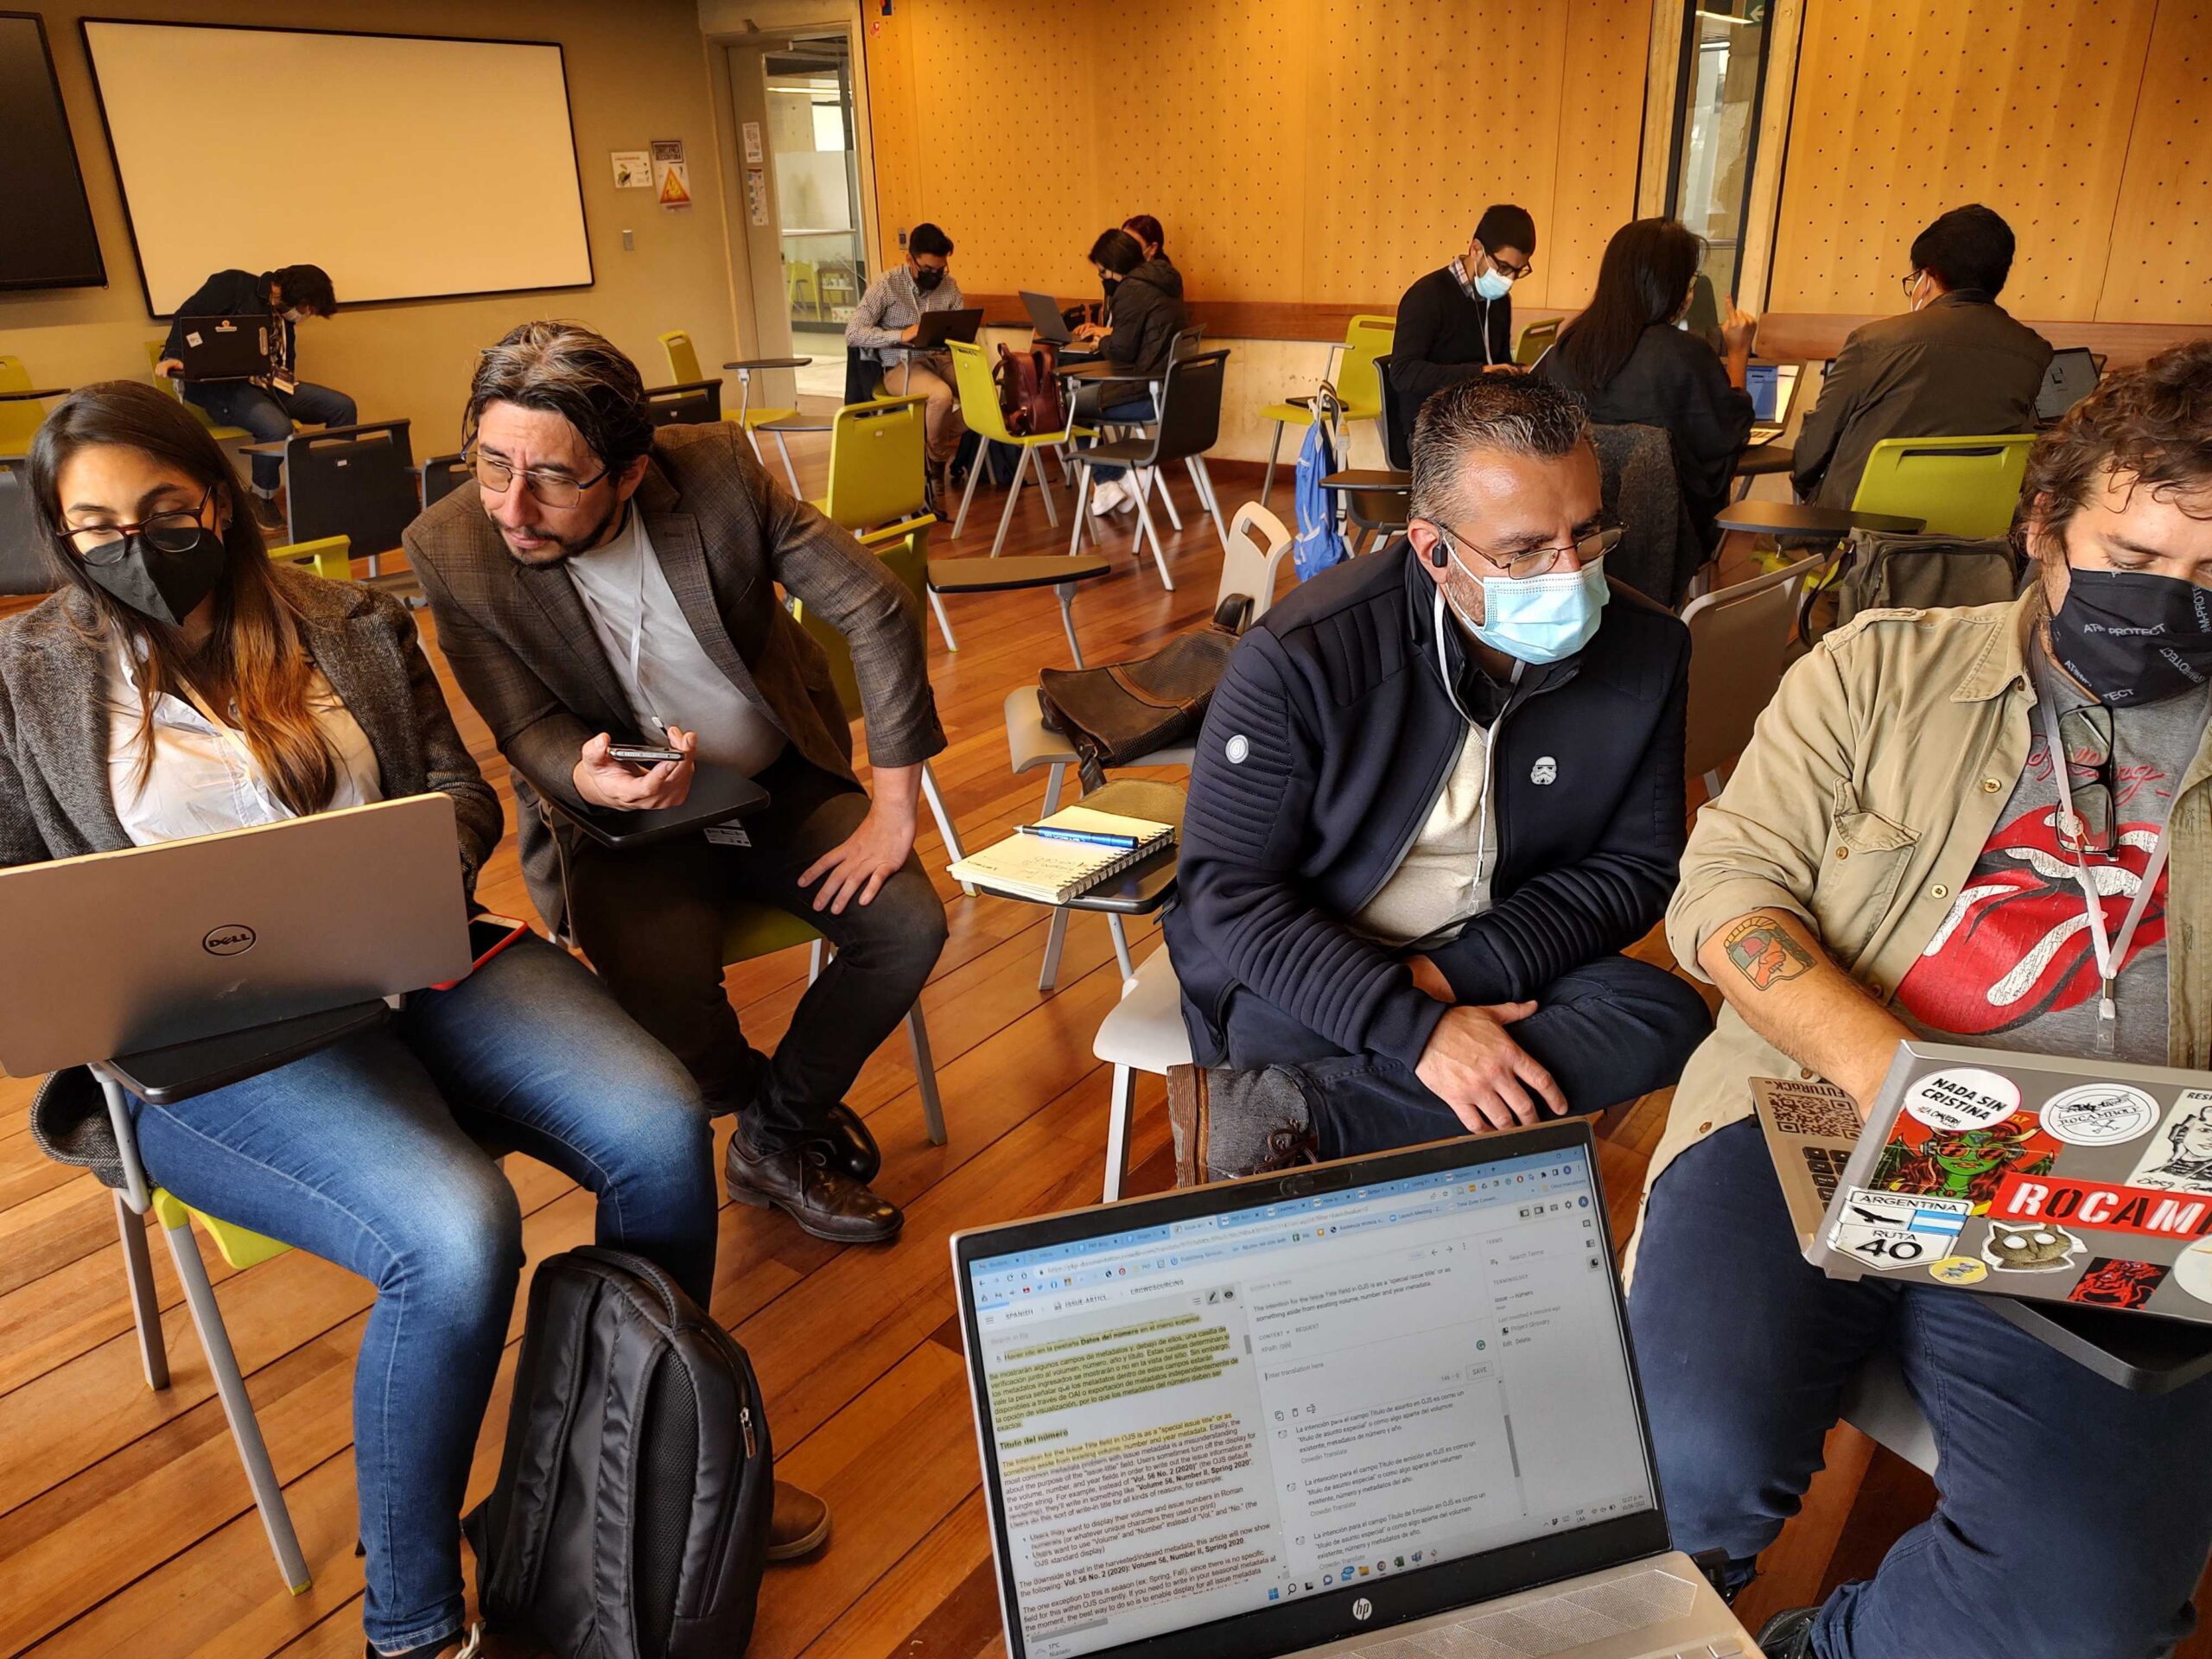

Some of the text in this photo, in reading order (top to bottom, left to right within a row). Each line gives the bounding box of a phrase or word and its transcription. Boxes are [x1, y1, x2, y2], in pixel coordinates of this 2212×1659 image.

[208, 933, 251, 948] DELL
[1921, 1088, 1992, 1121] CRISTINA
[1932, 1077, 2008, 1112] NADA SIN
[1859, 1195, 1959, 1212] ARGENTINA
[2006, 1181, 2212, 1236] ROCAM
[1855, 1238, 1923, 1260] 40
[1872, 1230, 1917, 1242] RUTA
[1255, 1289, 1381, 1323] something number
[1079, 1334, 1101, 1344] Datos
[1112, 1326, 1139, 1338] número
[1501, 1338, 1513, 1347] Edit
[1514, 1335, 1532, 1344] Delete
[1281, 1363, 1312, 1376] translation
[1471, 1366, 1488, 1376] SAVE
[1183, 1417, 1201, 1427] issue
[998, 1437, 1023, 1450] Título
[1037, 1427, 1069, 1441] número
[1208, 1442, 1243, 1457] information
[1001, 1462, 1037, 1478] something
[1123, 1437, 1148, 1449] number
[1161, 1433, 1177, 1442] year
[1003, 1427, 1238, 1485] most common issue metadata misunderstanding
[1004, 1433, 1247, 1494] about purpose Users sometimes display
[1013, 1499, 1034, 1511] single
[1096, 1478, 1122, 1491] instead
[1226, 1450, 1249, 1461] default
[1087, 1487, 1122, 1503] something
[1173, 1469, 1202, 1482] Number
[1208, 1462, 1232, 1475] Spring
[1052, 1510, 1067, 1519] sort
[1074, 1502, 1099, 1514] write-in
[1071, 1499, 1217, 1540] whatever unique characters used print)
[1090, 1484, 1244, 1529] display volume issue numbers Roman
[1052, 1544, 1069, 1554] want
[1165, 1515, 1189, 1527] instead
[1033, 1570, 1065, 1585] downside
[1207, 1531, 1228, 1542] article
[1049, 1550, 1079, 1564] standard
[1078, 1544, 1105, 1559] display)
[1063, 1576, 1077, 1586] Vol.
[1130, 1557, 1158, 1570] Volume
[1168, 1548, 1197, 1560] Number
[1204, 1540, 1228, 1554] Spring
[1227, 1535, 1244, 1547] 2020
[1210, 1562, 1240, 1576] seasonal
[1239, 1555, 1269, 1569] metadata
[1050, 1548, 1265, 1608] exception season specific
[1077, 1608, 1093, 1618] best
[1148, 1588, 1172, 1600] enable
[1172, 1582, 1196, 1596] display
[1354, 1598, 1371, 1620] hp
